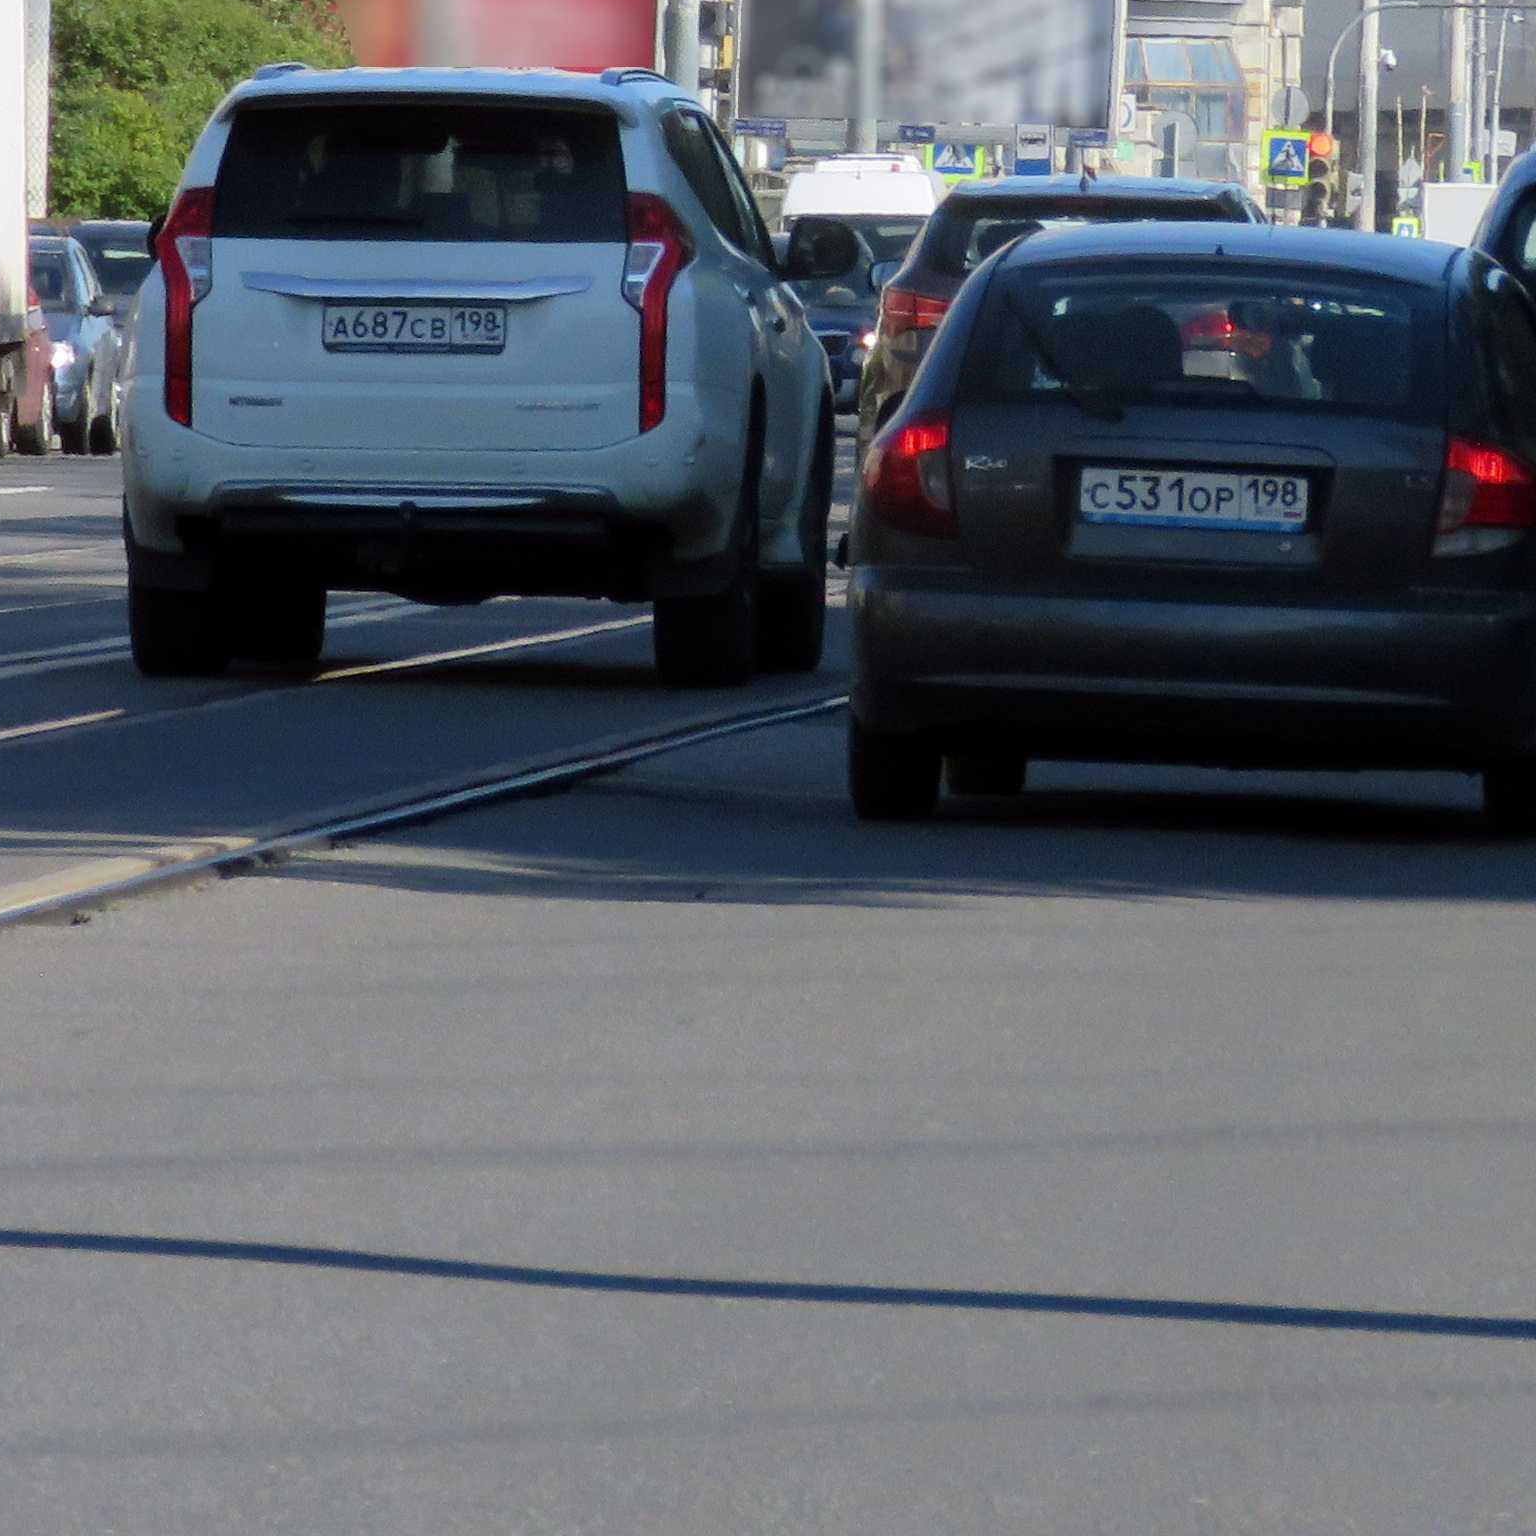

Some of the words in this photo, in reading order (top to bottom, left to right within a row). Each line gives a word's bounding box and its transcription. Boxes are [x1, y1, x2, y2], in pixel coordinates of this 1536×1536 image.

[332, 310, 446, 340] А687СВ
[454, 311, 500, 333] 198
[1089, 474, 1235, 513] С531ОР
[1245, 478, 1300, 508] 198
